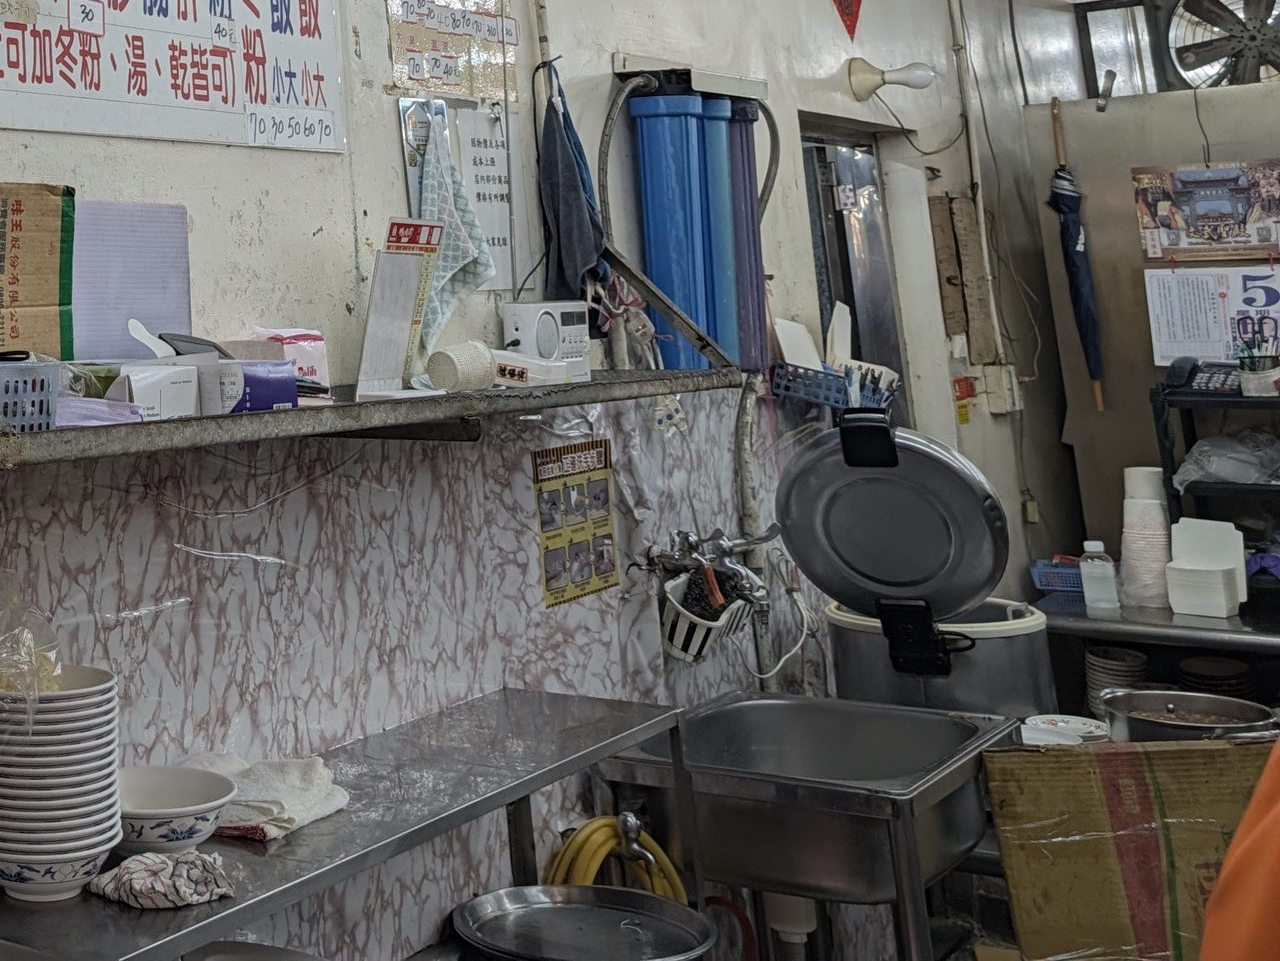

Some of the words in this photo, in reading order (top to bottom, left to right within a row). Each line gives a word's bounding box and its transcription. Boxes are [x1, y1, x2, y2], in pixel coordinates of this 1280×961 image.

[80, 4, 95, 22] 30
[9, 197, 24, 340] 味王股份有限公司
[1241, 274, 1280, 308] 5
